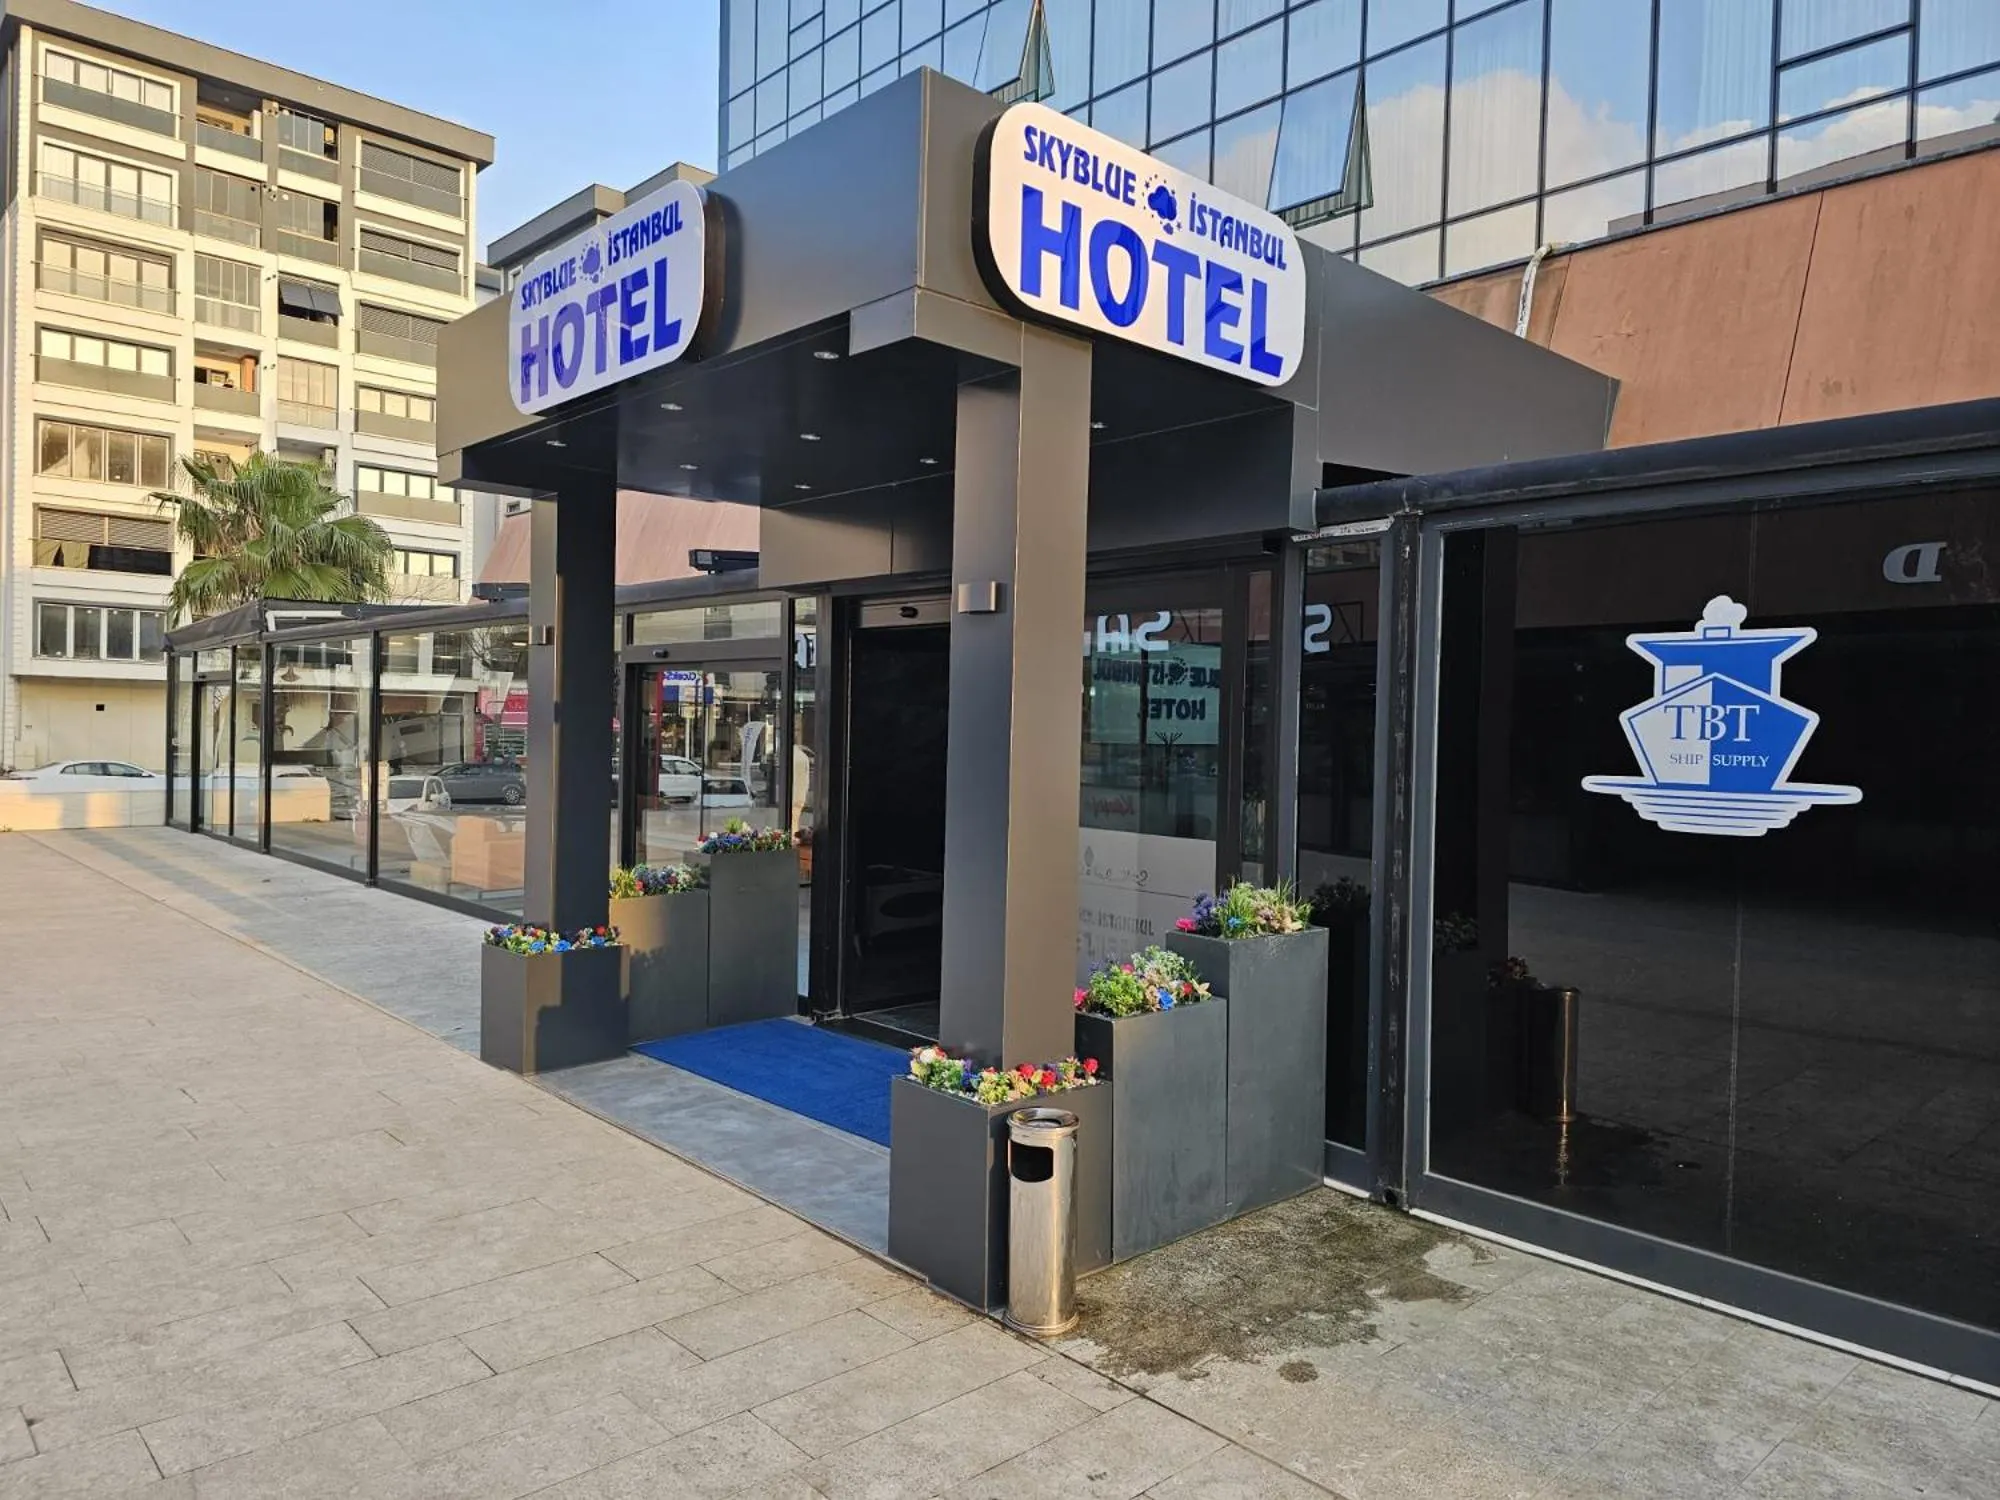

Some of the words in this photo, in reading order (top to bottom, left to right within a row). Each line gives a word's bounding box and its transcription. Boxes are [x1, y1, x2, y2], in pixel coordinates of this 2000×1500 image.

[521, 257, 577, 311] SKYBLUE
[608, 200, 684, 266] İSTANBUL
[1023, 124, 1137, 206] SKYBLUE
[1189, 192, 1287, 271] İSTANBUL
[520, 256, 683, 405] HOTEL
[1020, 183, 1284, 378] HOTEL
[1663, 704, 1761, 742] TBT
[1669, 753, 1704, 765] SHIP
[1712, 754, 1770, 768] SUPPLY
